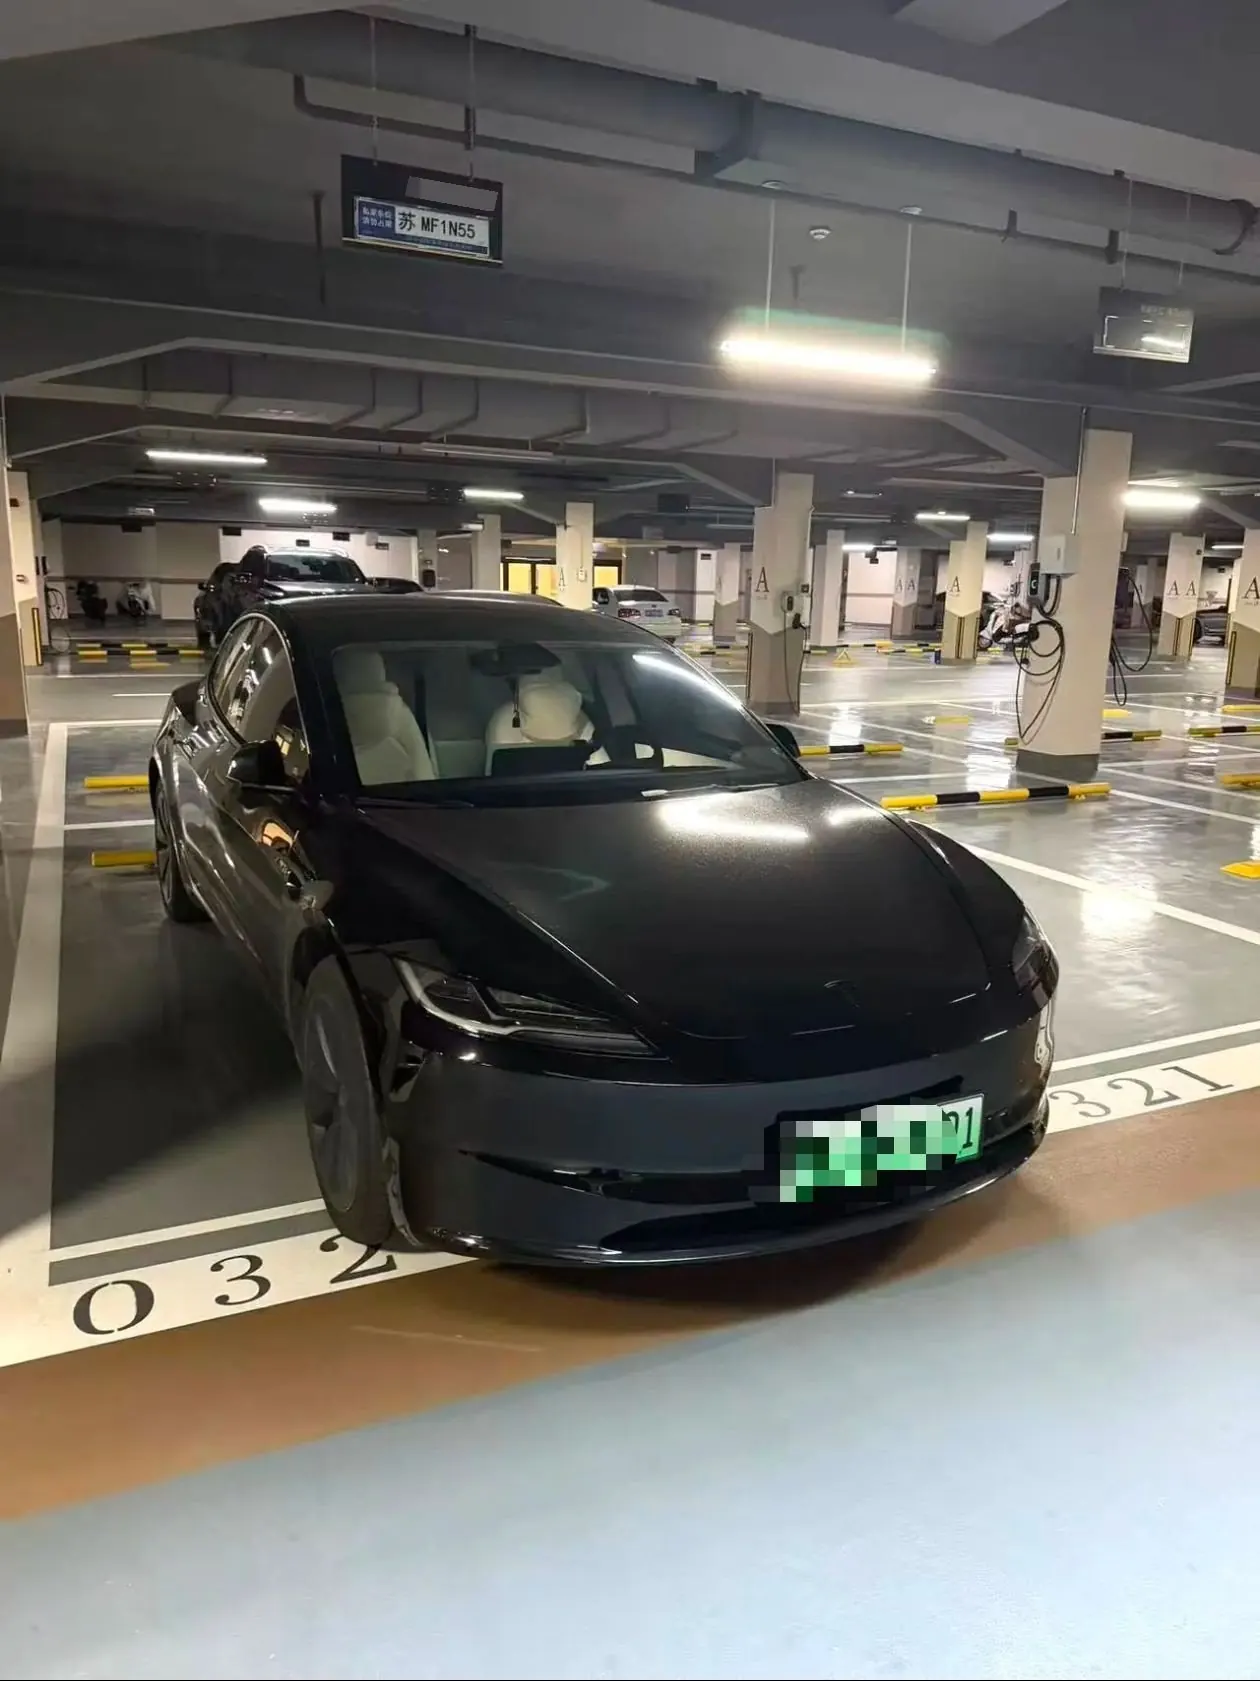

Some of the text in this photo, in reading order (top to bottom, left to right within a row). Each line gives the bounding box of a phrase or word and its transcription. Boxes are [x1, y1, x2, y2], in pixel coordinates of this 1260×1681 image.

[398, 211, 476, 239] 苏 MF1N55
[755, 566, 770, 592] A
[950, 576, 960, 593] A
[1167, 580, 1180, 596] A
[1185, 580, 1197, 596] A
[1242, 576, 1260, 599] A
